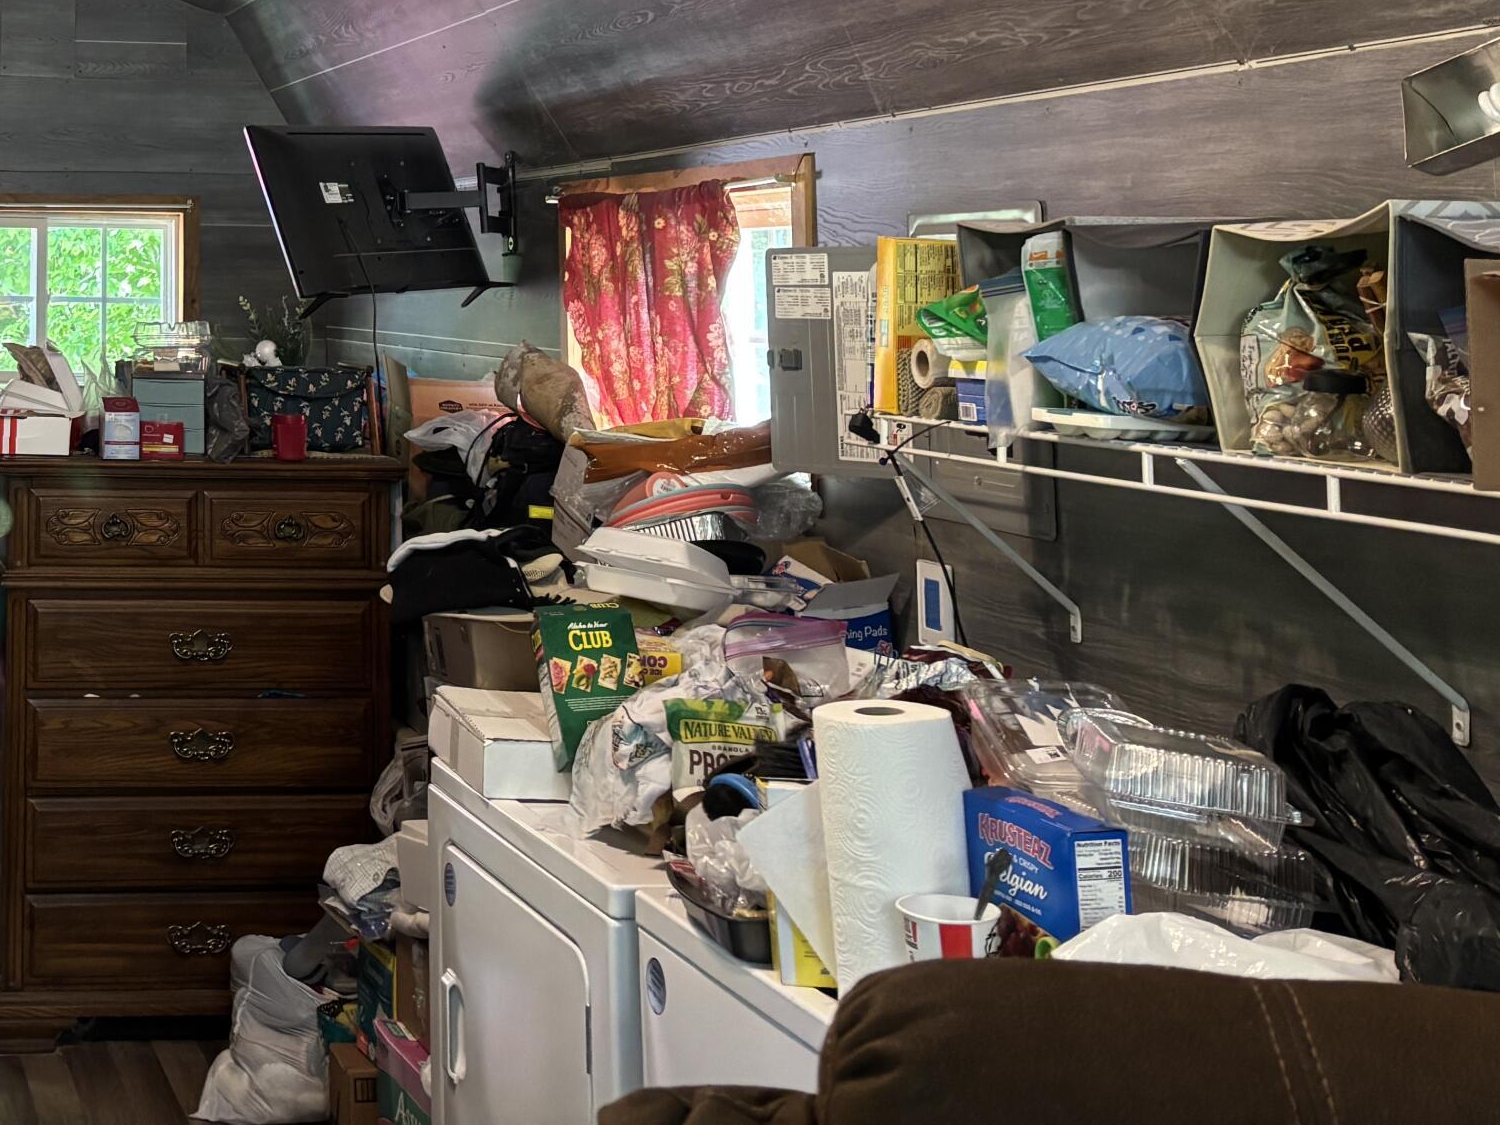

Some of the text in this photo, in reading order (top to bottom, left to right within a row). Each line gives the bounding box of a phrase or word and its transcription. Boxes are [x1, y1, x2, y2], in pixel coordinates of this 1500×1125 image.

[865, 626, 888, 638] Pads
[568, 630, 613, 651] CLUB
[684, 721, 773, 742] NATURE VALEY
[711, 744, 749, 753] GRANOLA
[979, 813, 1054, 870] KRUSTEAZ
[1107, 870, 1123, 878] 200
